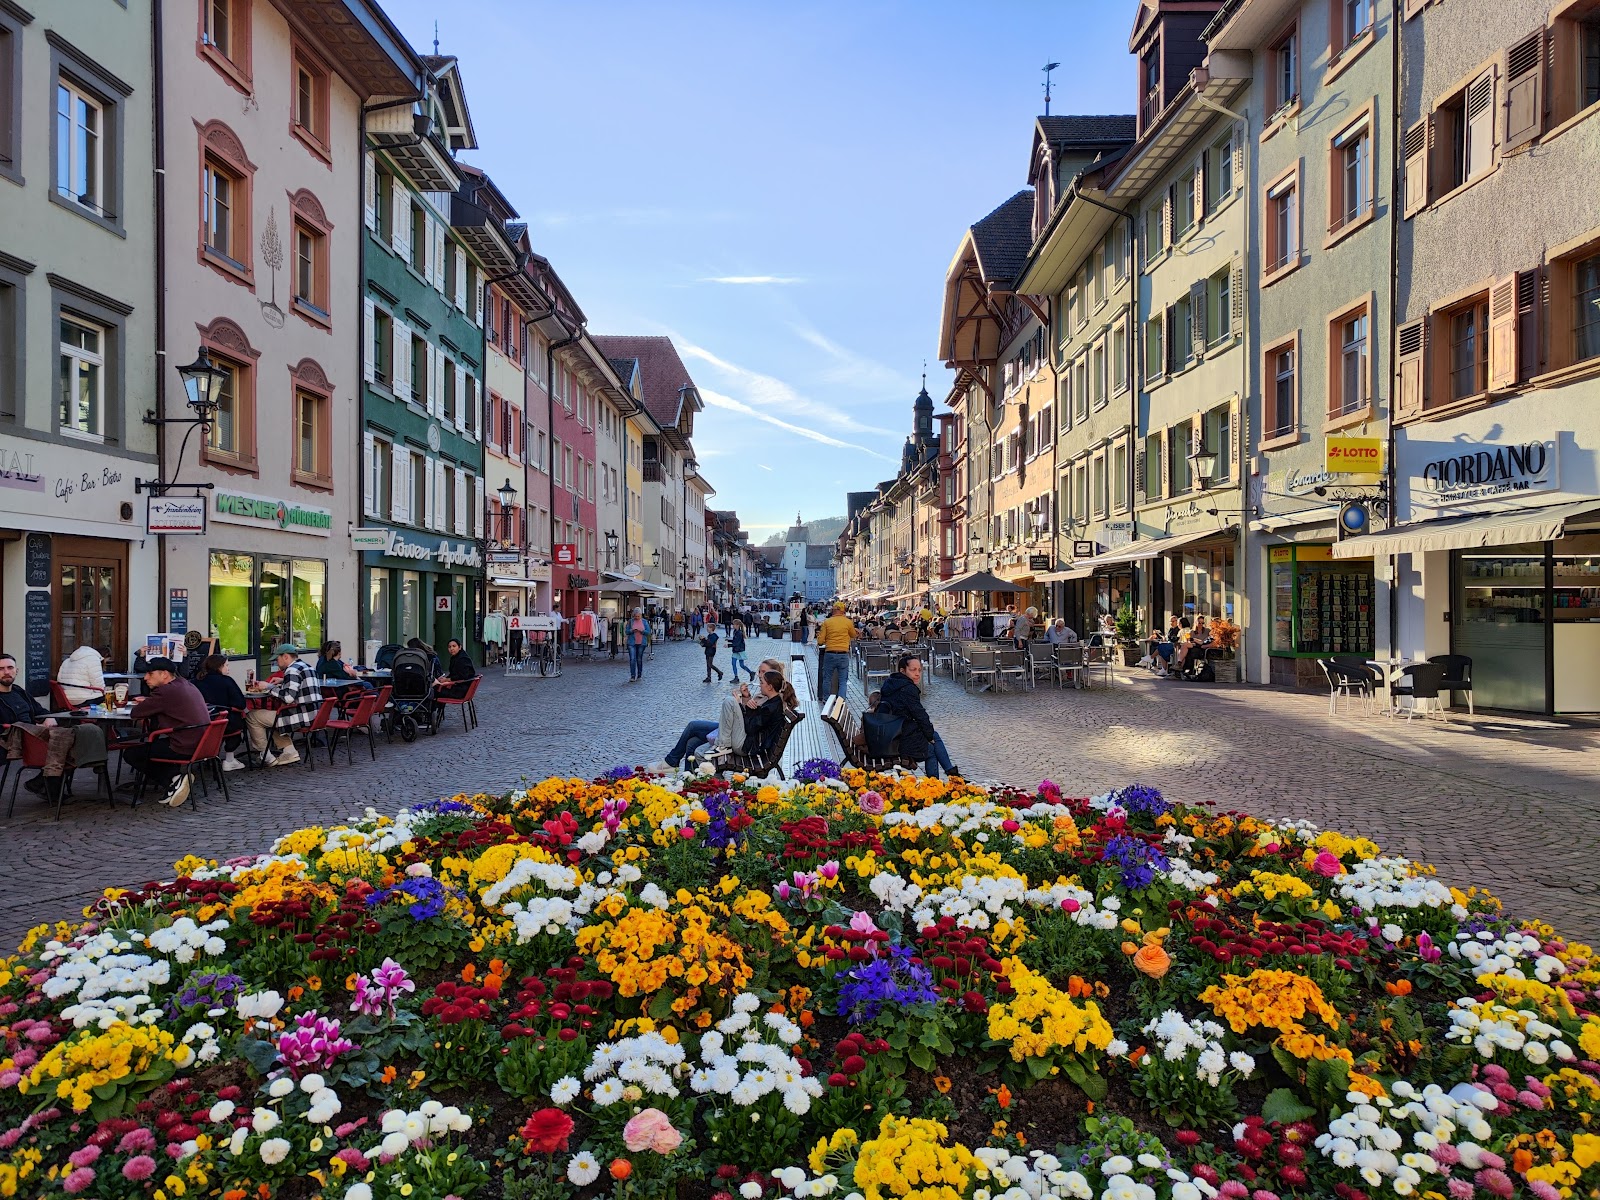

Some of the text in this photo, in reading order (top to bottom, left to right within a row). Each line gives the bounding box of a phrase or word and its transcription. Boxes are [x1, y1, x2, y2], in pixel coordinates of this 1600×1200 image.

[1344, 448, 1378, 457] LOTTO
[1424, 440, 1546, 492] GIORDANO
[55, 467, 122, 503] Café Bar Bistro
[1513, 480, 1530, 490] BAR
[217, 493, 332, 529] WIESNER HÖRGERÄTE
